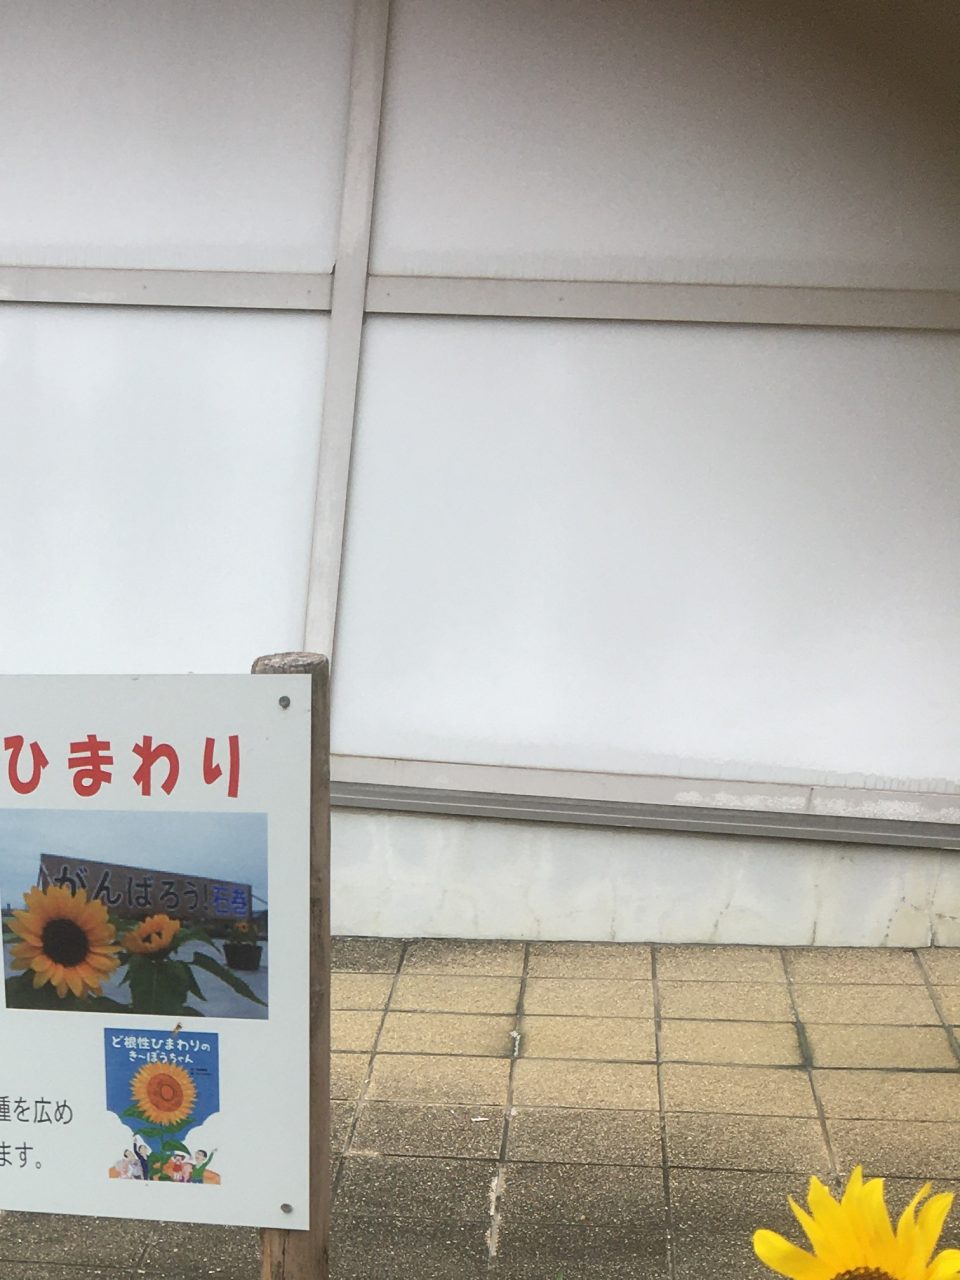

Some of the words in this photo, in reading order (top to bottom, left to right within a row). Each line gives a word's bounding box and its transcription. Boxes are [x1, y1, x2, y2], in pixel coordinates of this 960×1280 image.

[111, 1035, 211, 1052] ど根性ひまわりの
